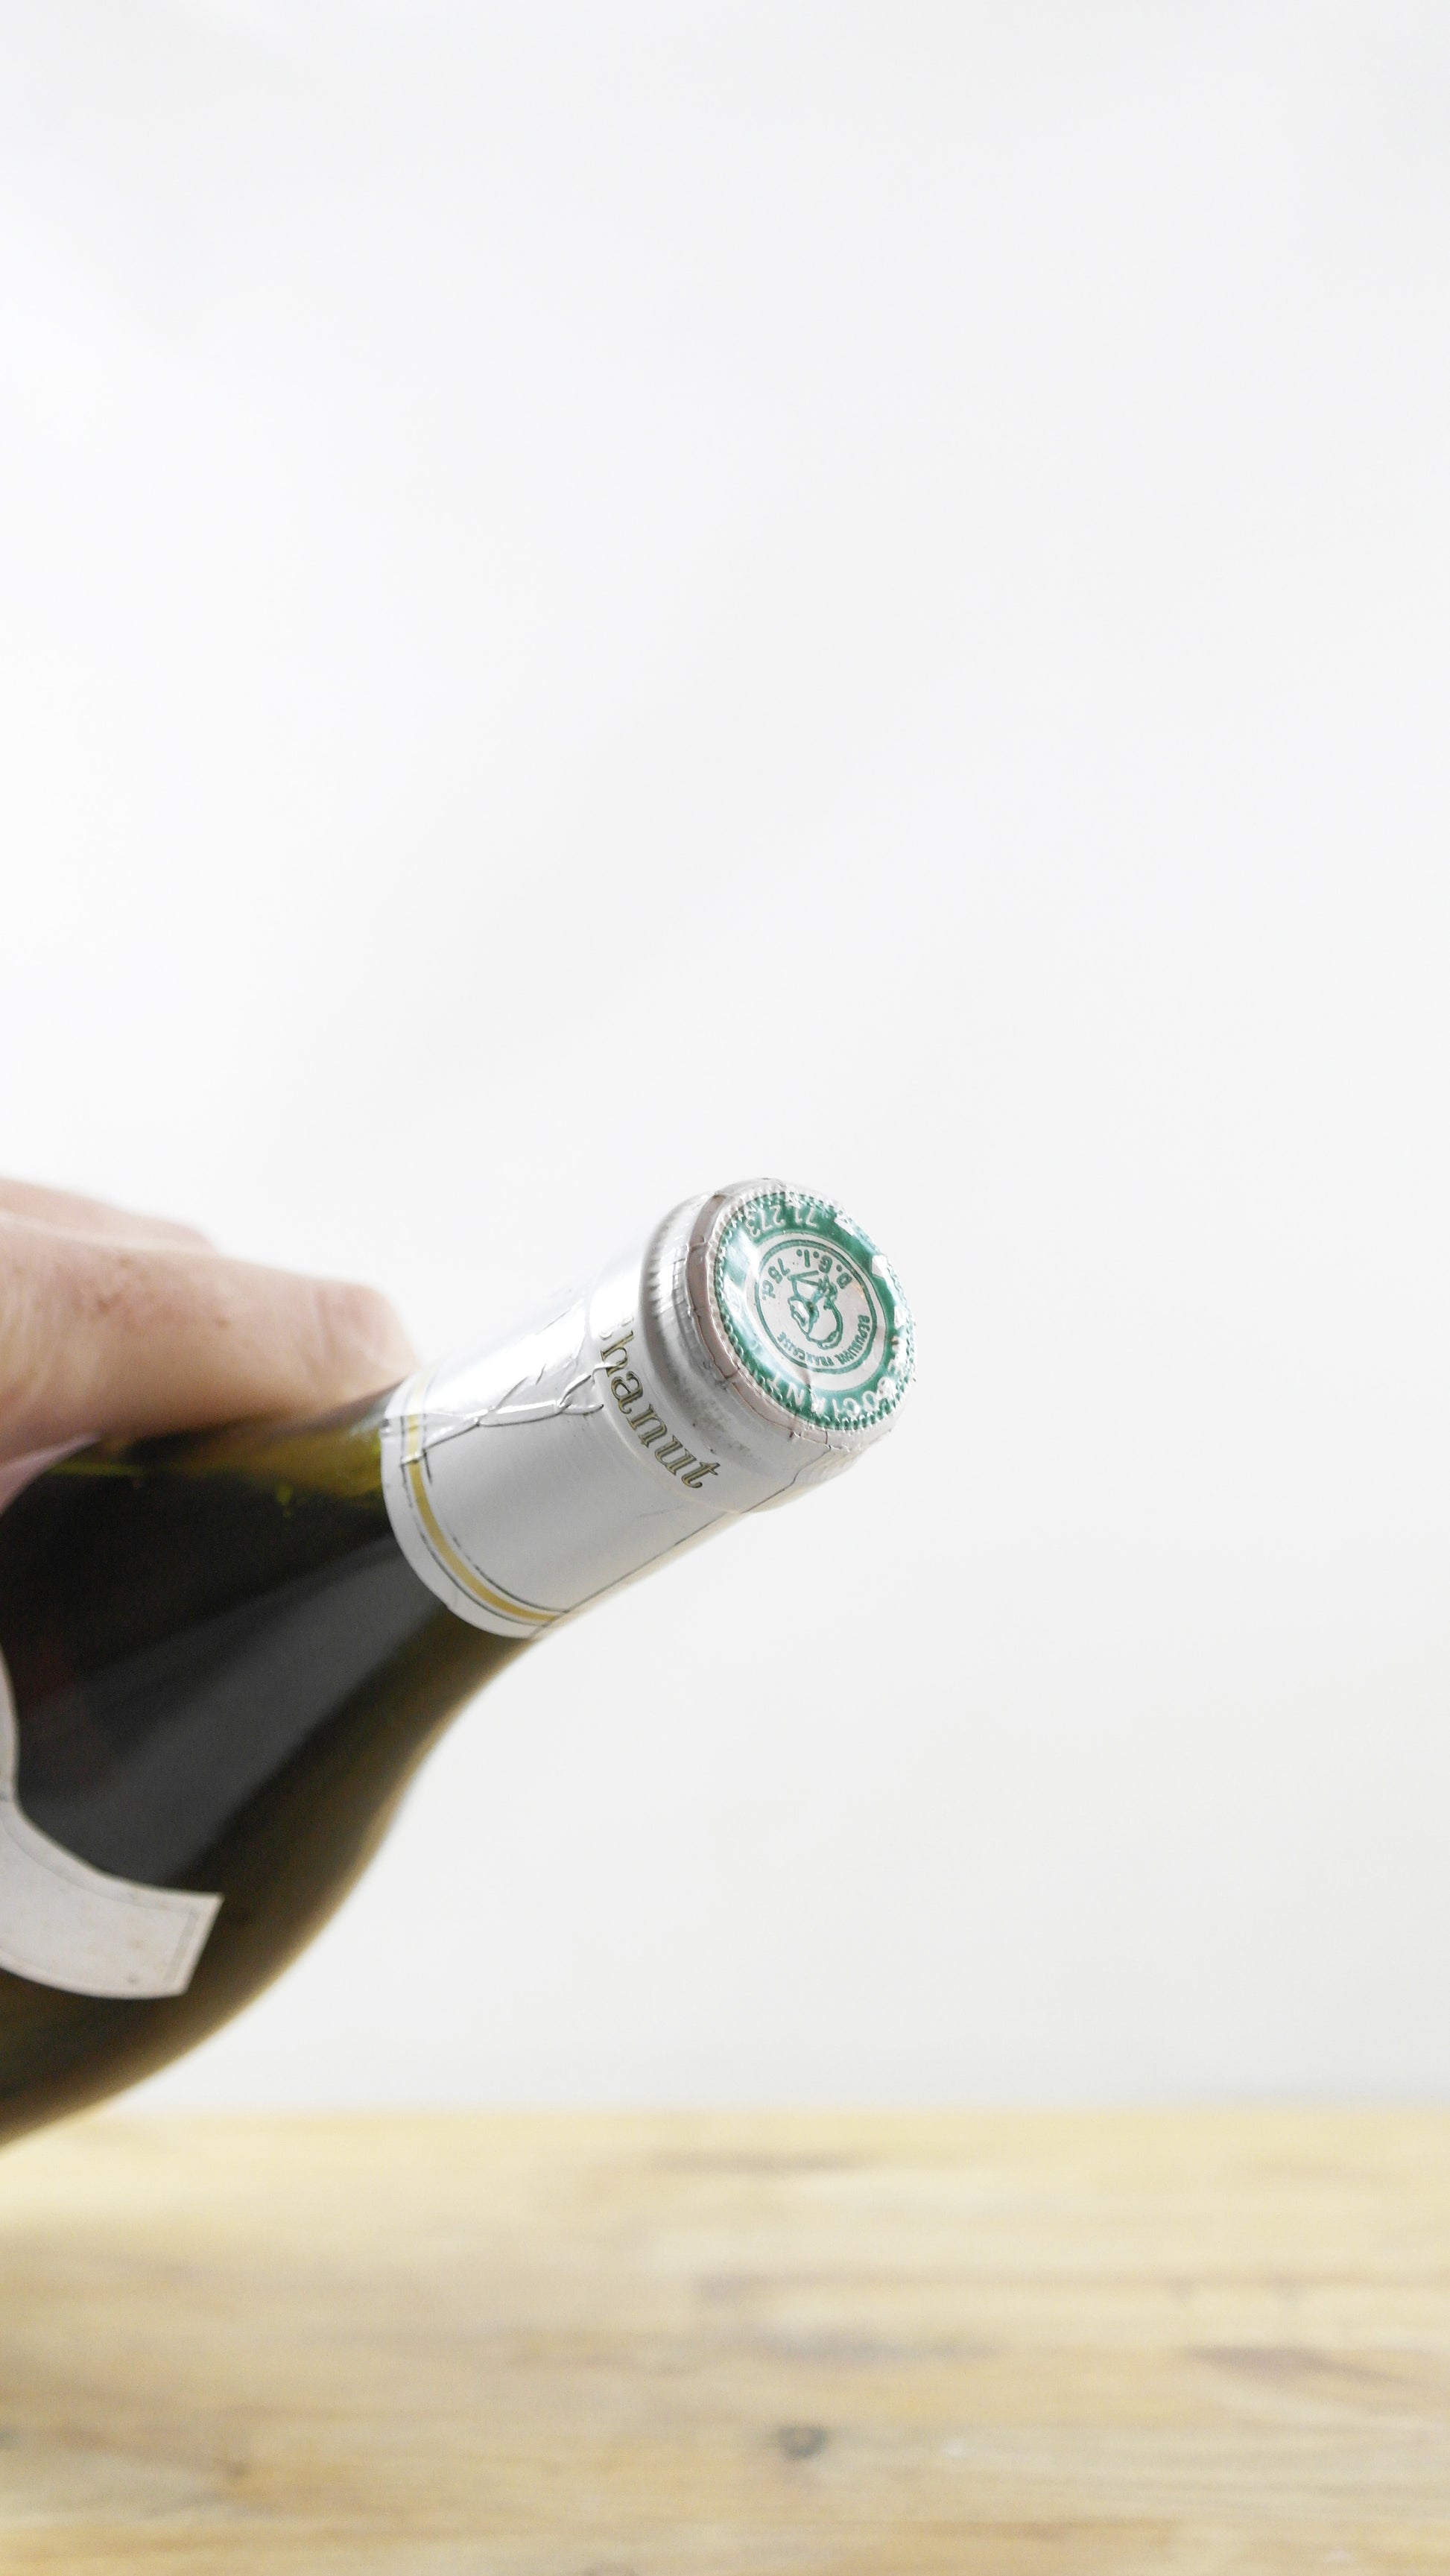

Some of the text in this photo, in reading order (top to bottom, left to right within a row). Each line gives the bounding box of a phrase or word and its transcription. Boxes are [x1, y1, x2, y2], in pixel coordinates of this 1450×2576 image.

[744, 1204, 819, 1238] 71 273
[767, 1257, 791, 1284] 75
[599, 1317, 721, 1489] hanut
